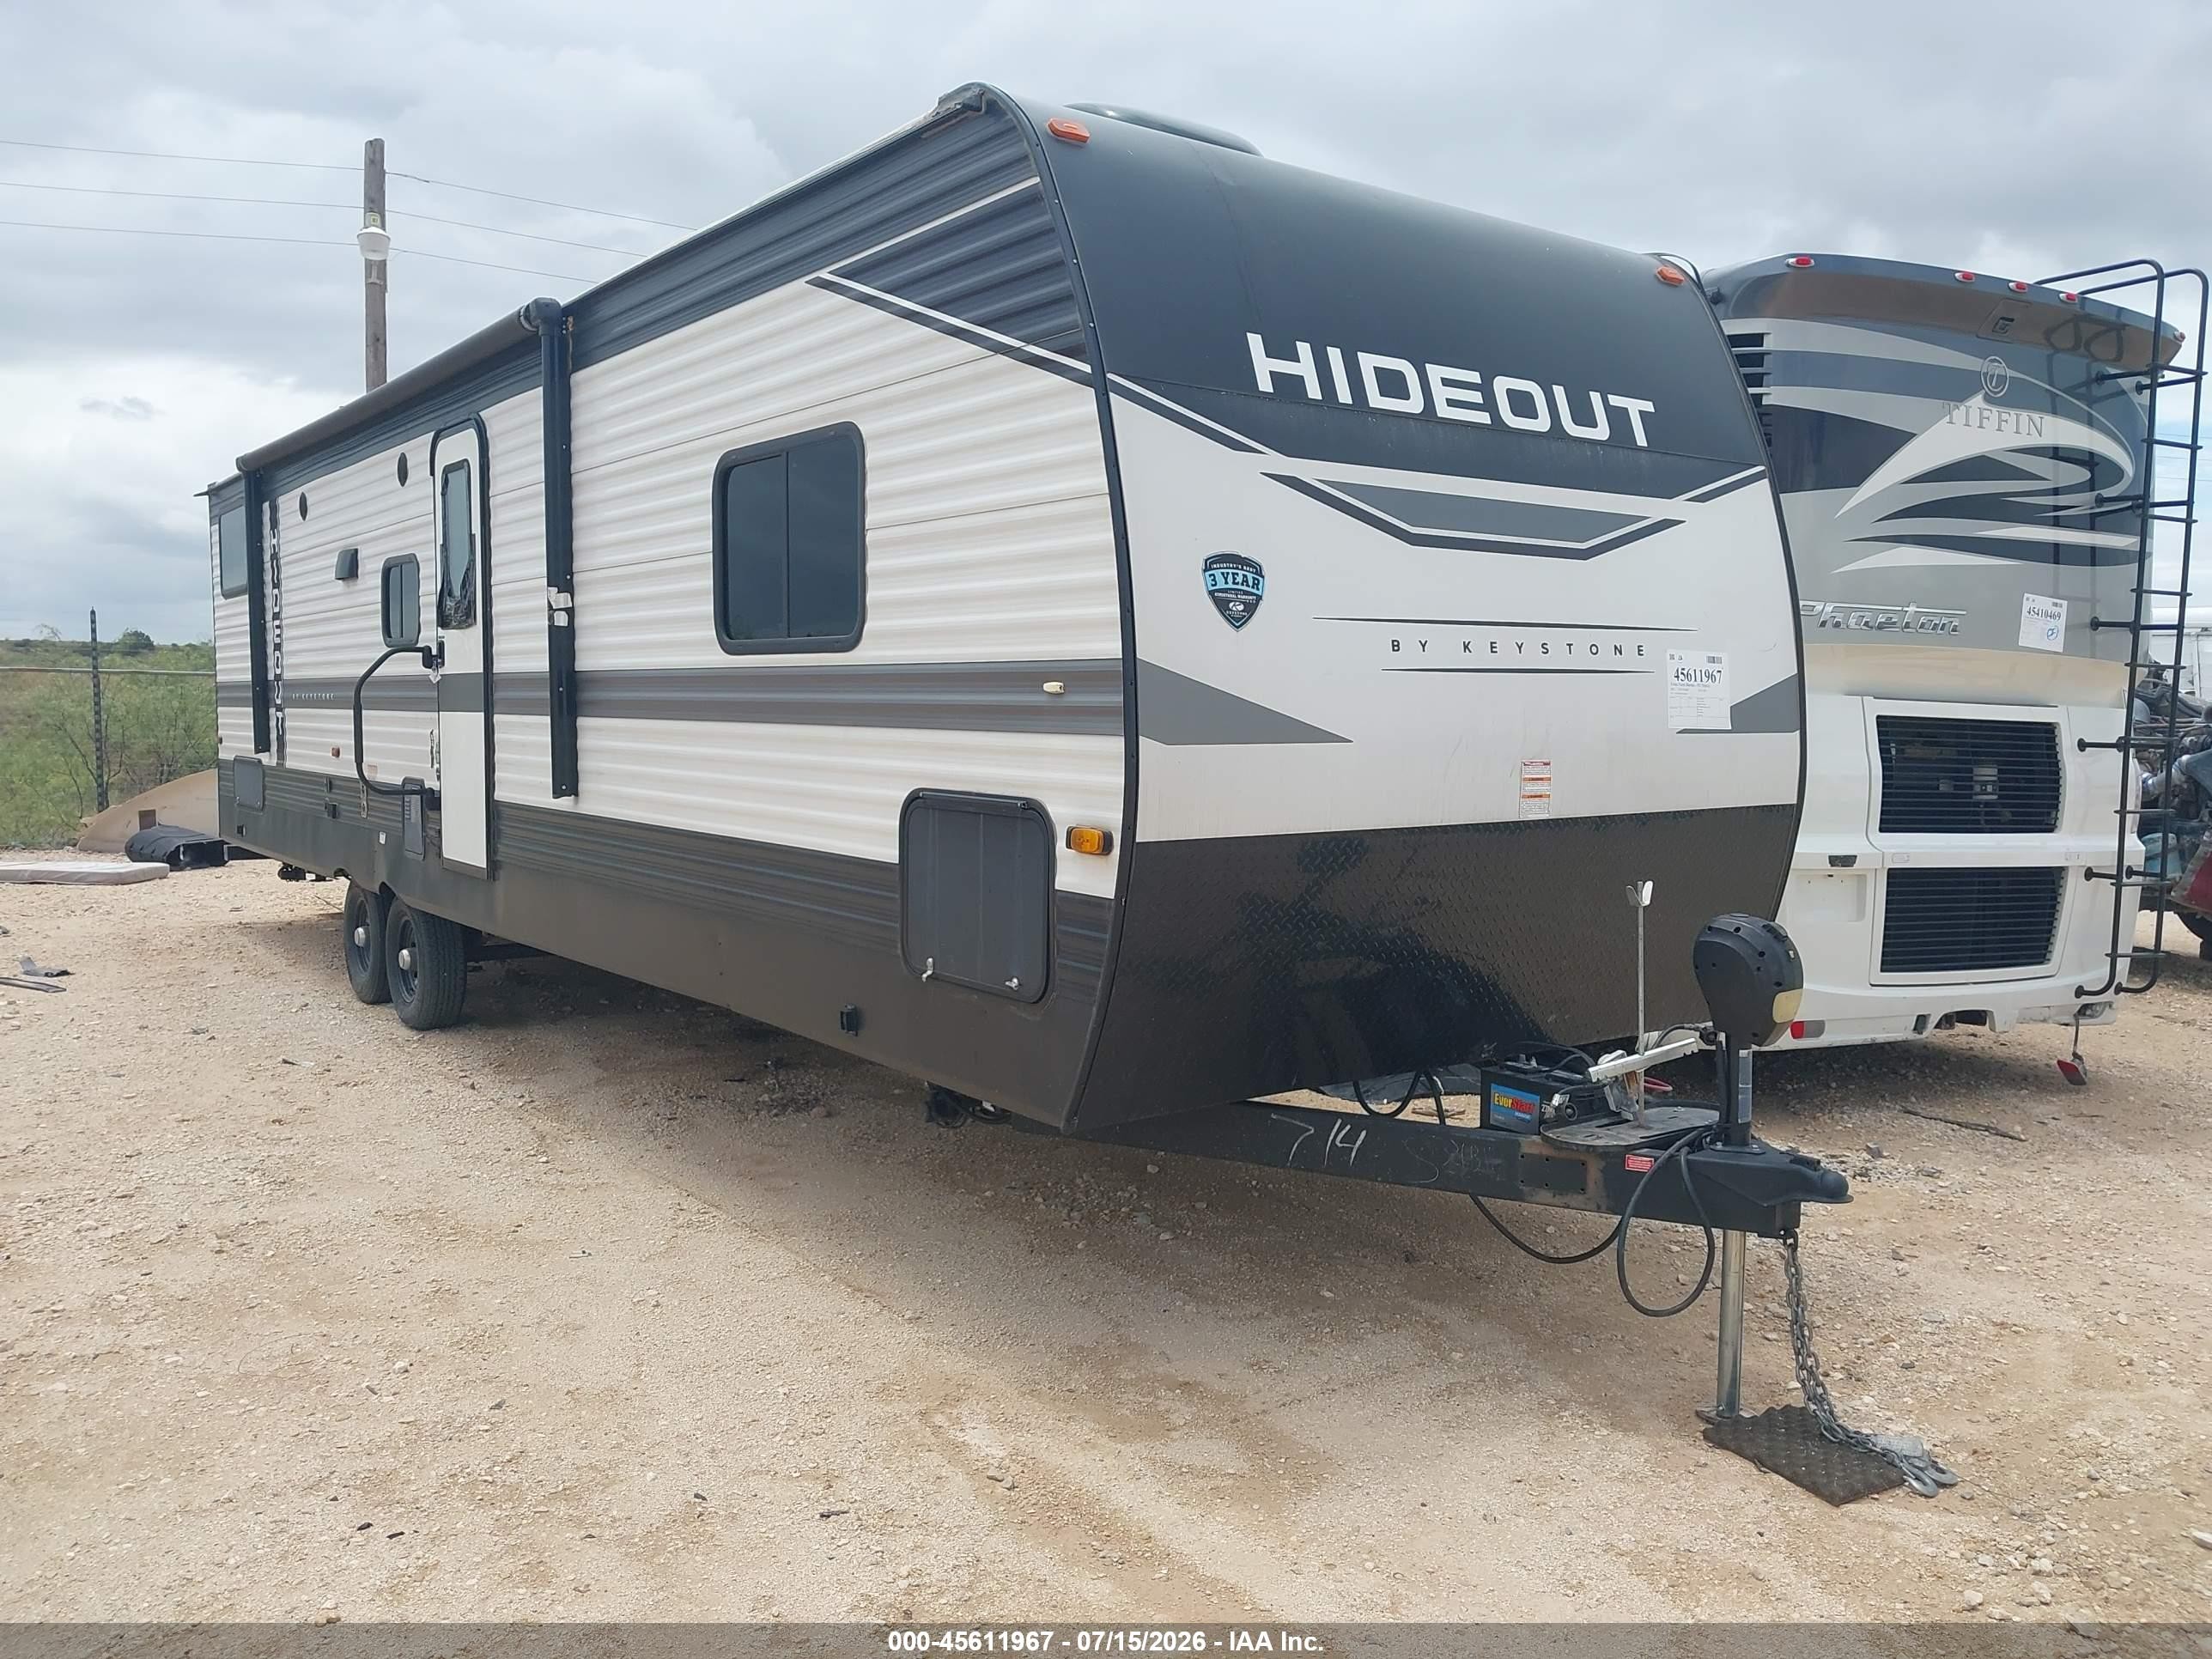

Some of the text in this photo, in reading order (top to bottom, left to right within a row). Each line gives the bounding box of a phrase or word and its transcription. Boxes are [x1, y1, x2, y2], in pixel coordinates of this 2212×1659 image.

[1246, 331, 1656, 447] HIDEOUT
[1942, 401, 2045, 438] TIFFIN
[1208, 571, 1261, 591] 3 YEAR
[2027, 605, 2062, 622] 45410469
[270, 528, 283, 736] HIDEOUT
[1391, 639, 1644, 657] BY KEYSTONE
[1674, 667, 1723, 684] 45611967
[1494, 1092, 1535, 1115] EverStart
